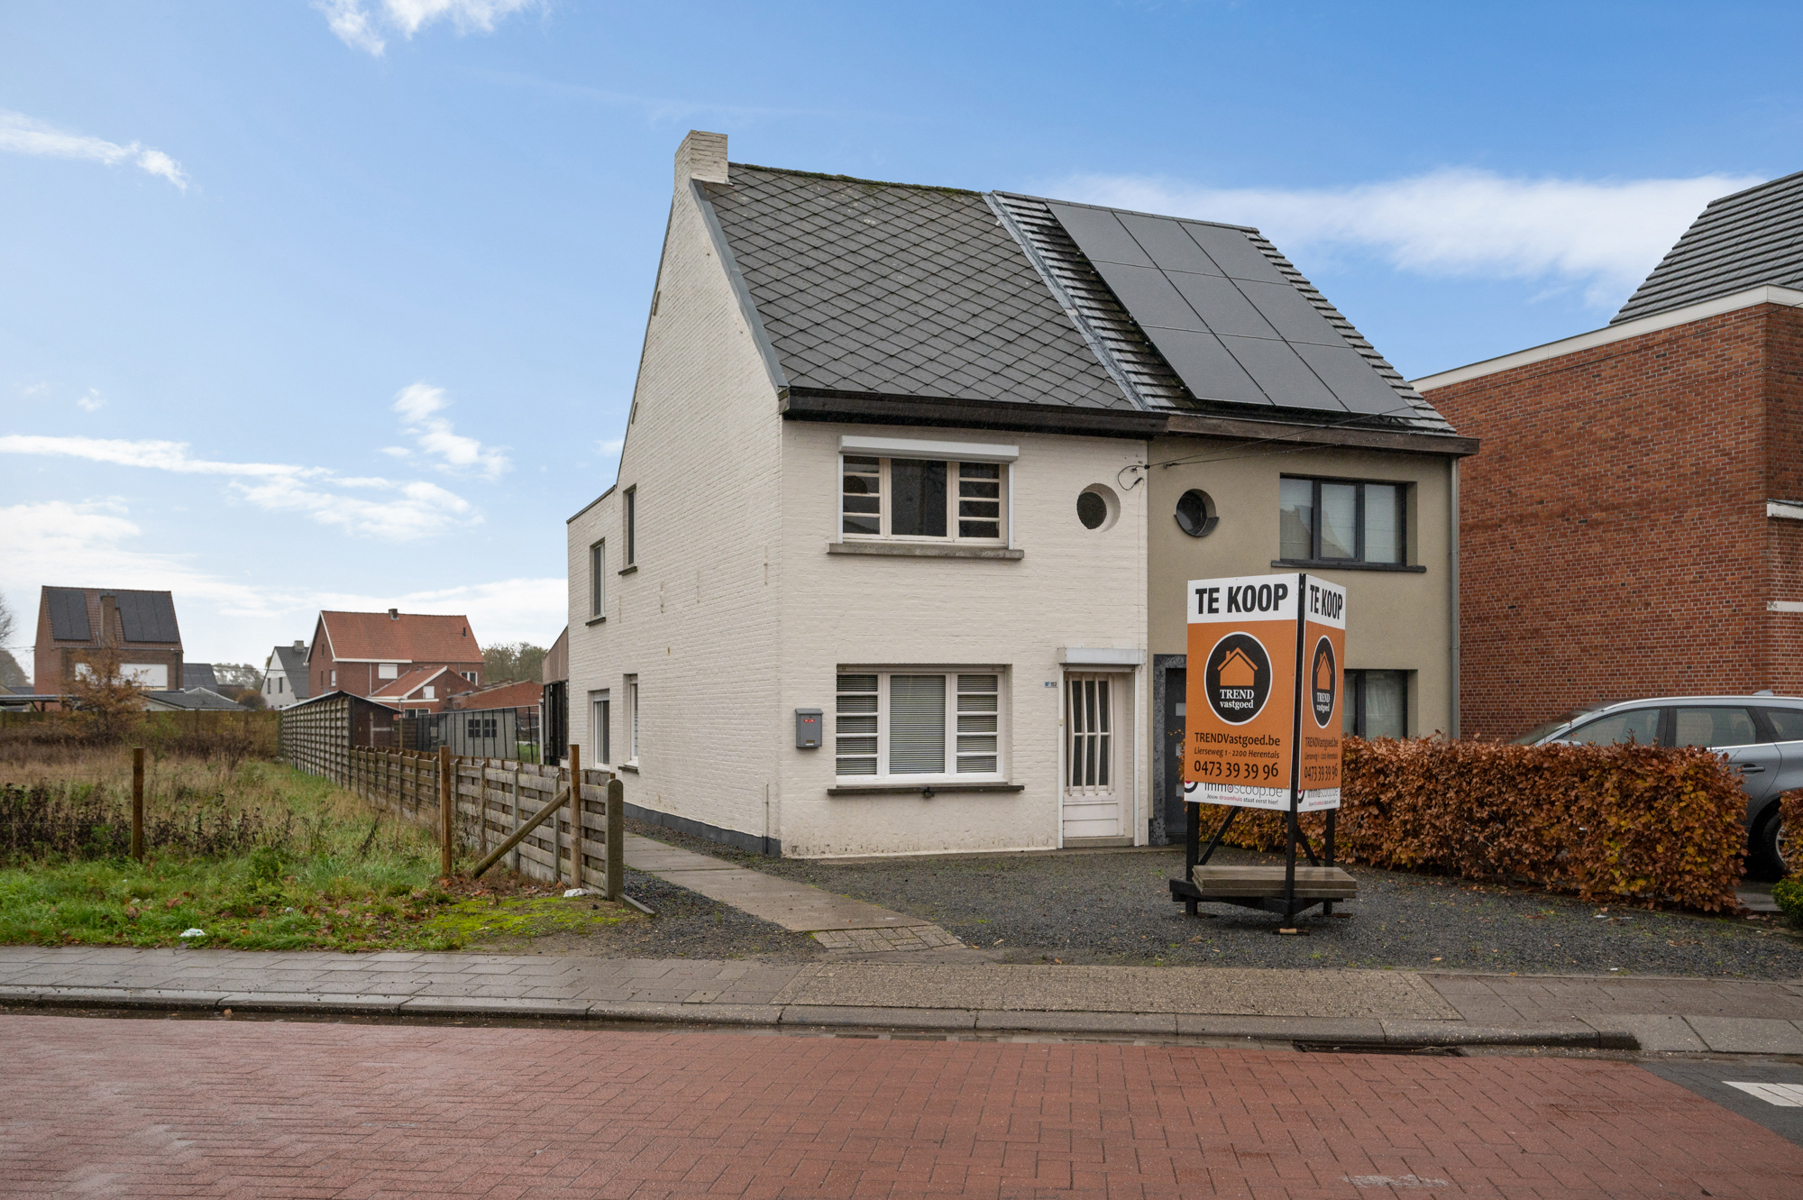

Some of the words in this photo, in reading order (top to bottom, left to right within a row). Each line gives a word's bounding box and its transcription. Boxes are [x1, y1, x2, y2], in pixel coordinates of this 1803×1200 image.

[1195, 587, 1220, 614] TE
[1227, 583, 1288, 613] KOOP
[1310, 584, 1319, 614] TE
[1321, 588, 1343, 620] KOOP
[1219, 689, 1254, 700] TREND
[1316, 692, 1330, 703] TREND
[1219, 699, 1254, 710] vastgoed
[1194, 732, 1281, 748] TRENDVastgoed.be
[1194, 747, 1224, 758] Lierseweg
[1248, 750, 1280, 759] Herentals
[1194, 760, 1222, 777] 0473
[1225, 762, 1240, 778] 39
[1243, 763, 1259, 780] 39
[1262, 762, 1279, 780] 96
